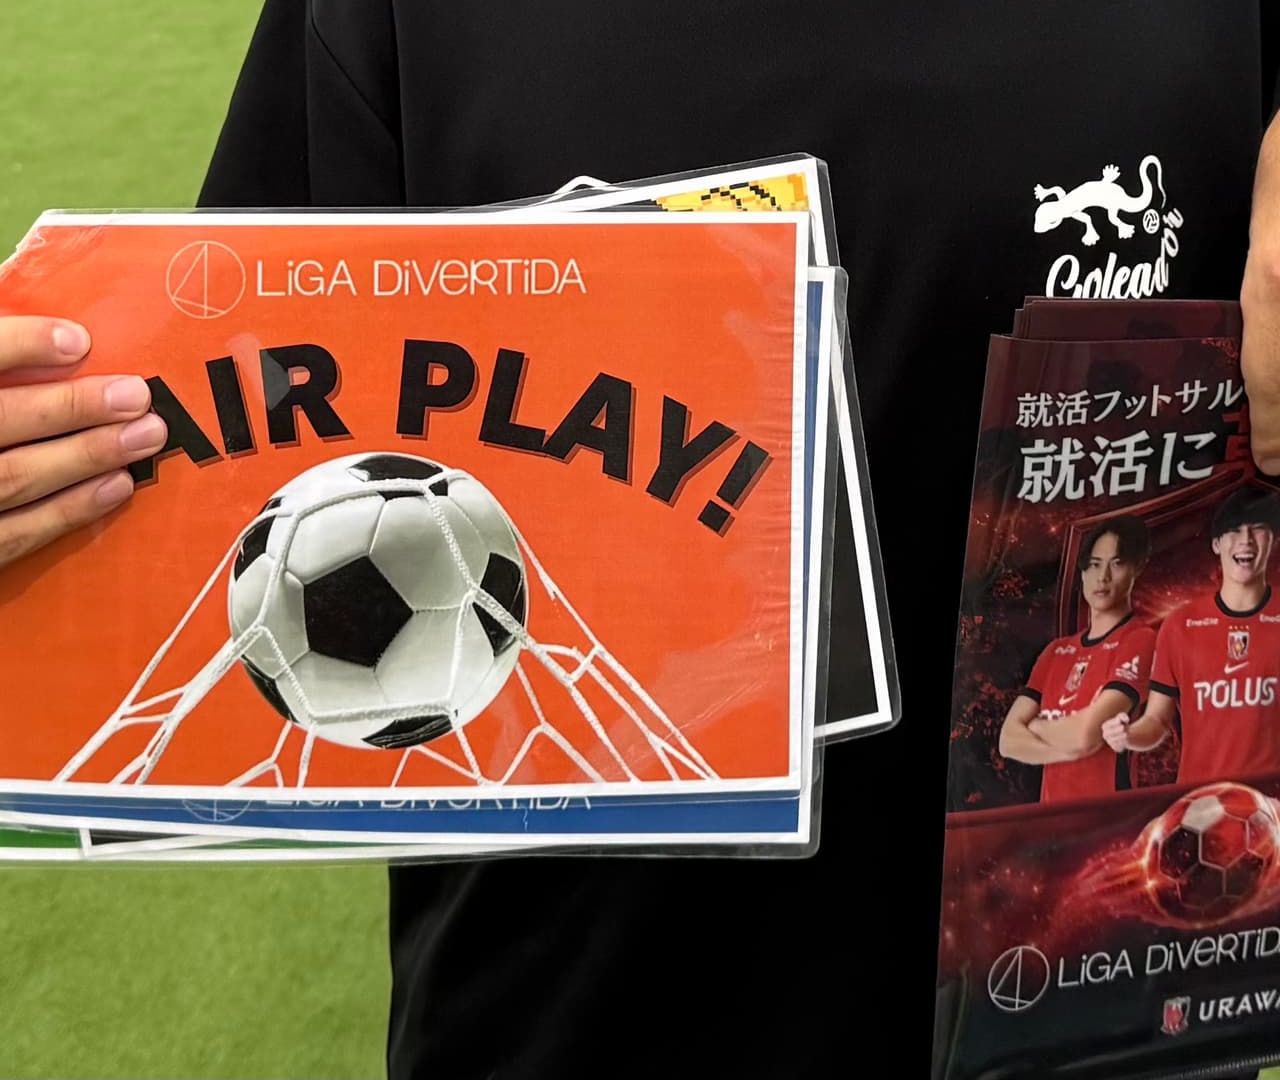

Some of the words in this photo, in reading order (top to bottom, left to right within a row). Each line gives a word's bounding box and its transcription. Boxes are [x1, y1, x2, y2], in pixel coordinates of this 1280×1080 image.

[1016, 378, 1244, 429] 就活フットサル
[127, 342, 357, 488] AIR
[394, 338, 773, 537] PLAY!
[1193, 676, 1279, 712] POLUS
